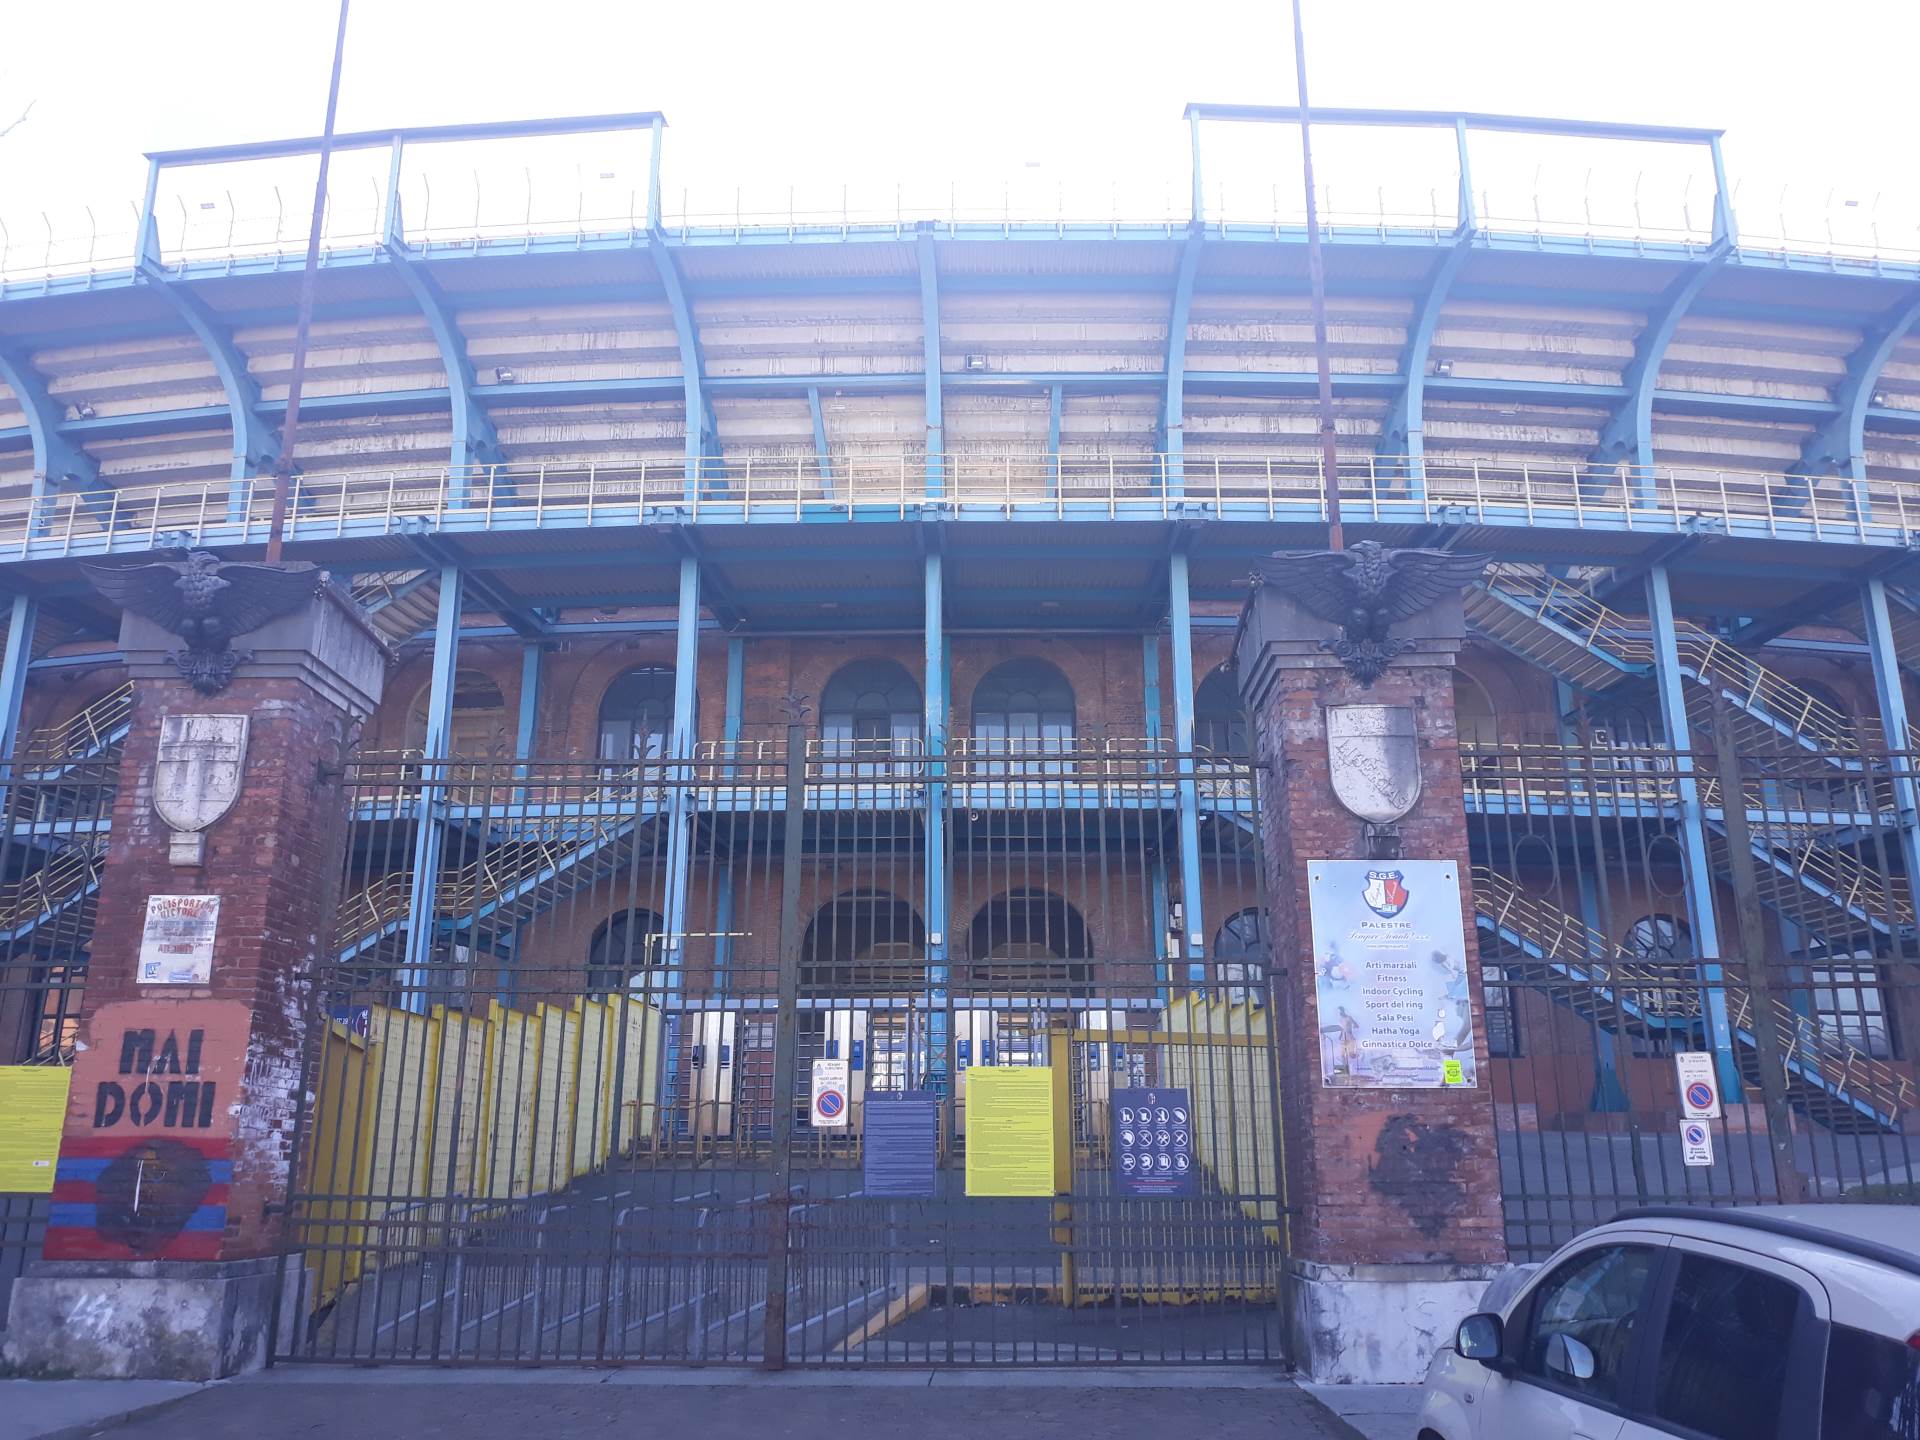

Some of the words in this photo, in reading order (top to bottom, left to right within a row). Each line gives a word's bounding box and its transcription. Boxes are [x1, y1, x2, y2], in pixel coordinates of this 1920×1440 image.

[1361, 921, 1412, 929] PALESTRE
[1365, 961, 1382, 969] Arti
[1383, 961, 1417, 969] marziali
[1377, 974, 1407, 982] Fitness
[1362, 987, 1391, 995] Indoor
[1392, 987, 1423, 997] Cycling
[1365, 1000, 1389, 1010] Sport
[1391, 1000, 1404, 1008] del
[1405, 1000, 1423, 1010] ring
[1376, 1013, 1395, 1022] Sala
[1396, 1013, 1414, 1022] Pesi
[1371, 1027, 1398, 1035] Hatha
[1399, 1027, 1420, 1037] Yoga
[1361, 1040, 1407, 1049] Ginnastica
[1408, 1040, 1433, 1048] Dolce
[118, 1028, 204, 1074] MAI
[93, 1081, 217, 1129] DOMI
